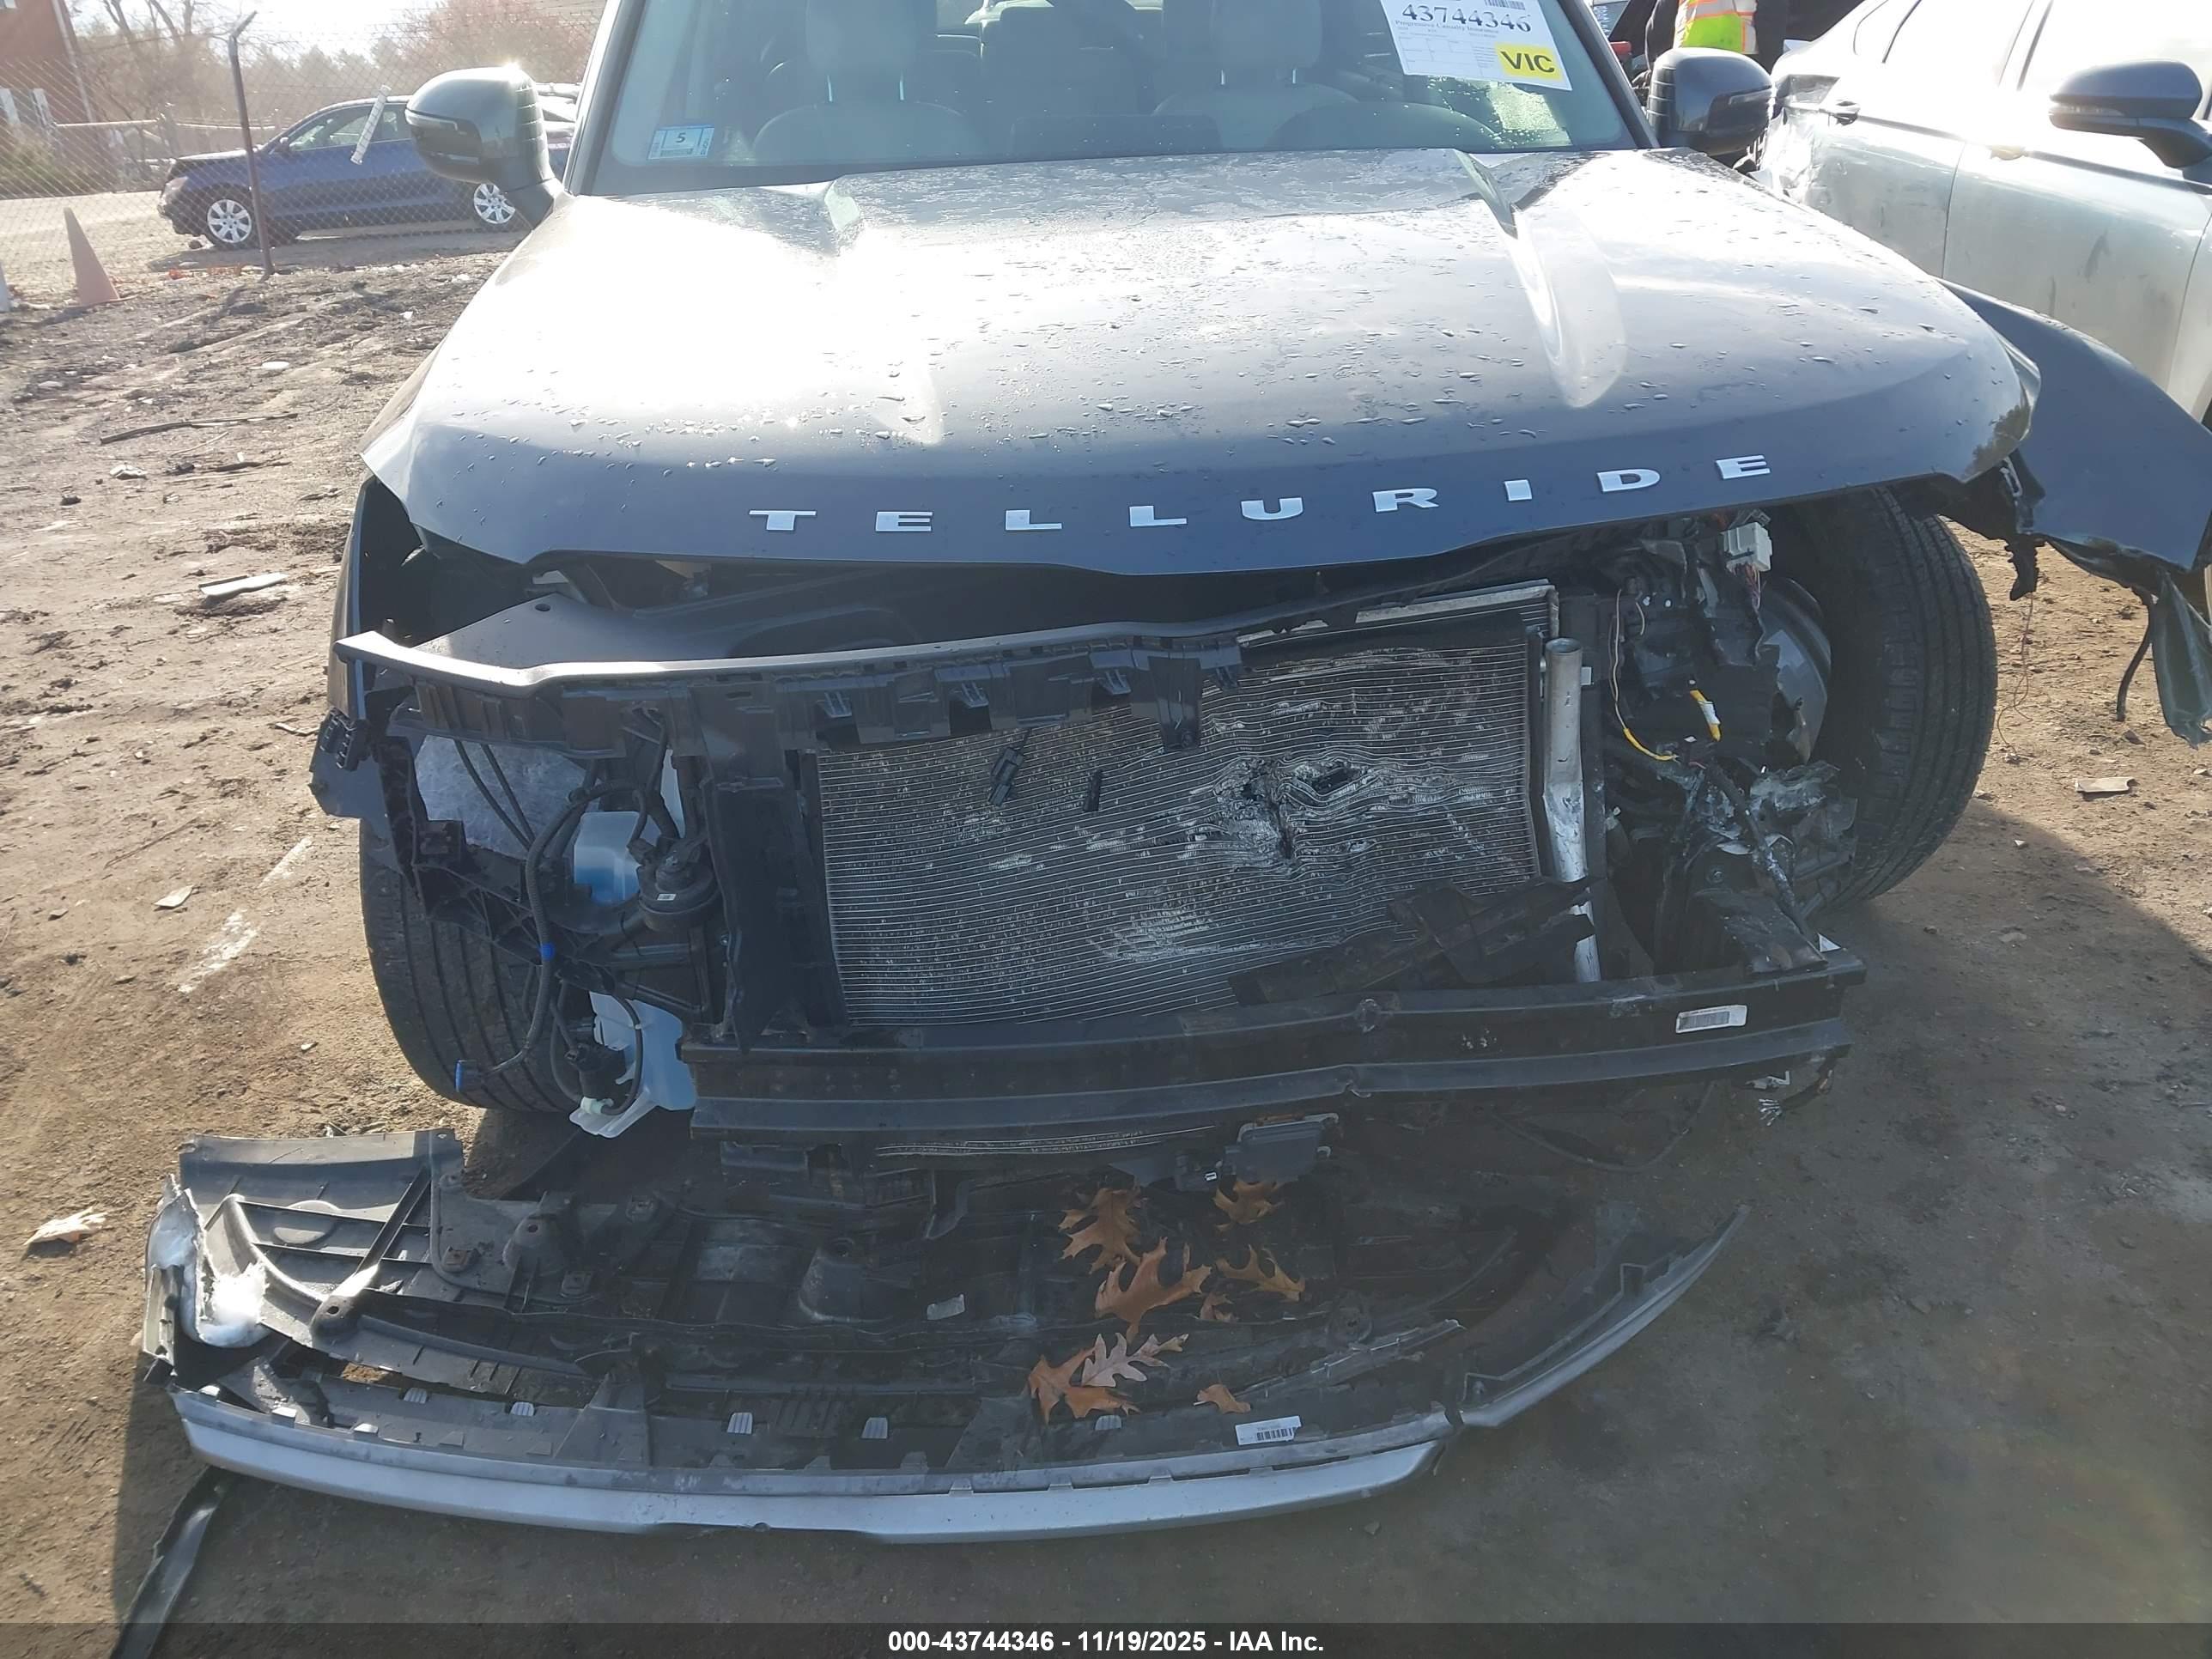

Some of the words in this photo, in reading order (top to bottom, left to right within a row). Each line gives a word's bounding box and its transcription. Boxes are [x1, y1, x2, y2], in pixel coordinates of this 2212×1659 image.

[1402, 3, 1531, 32] 43744346
[1500, 51, 1555, 73] VIC
[675, 132, 686, 143] 5
[749, 454, 1771, 532] TELLURIDE
